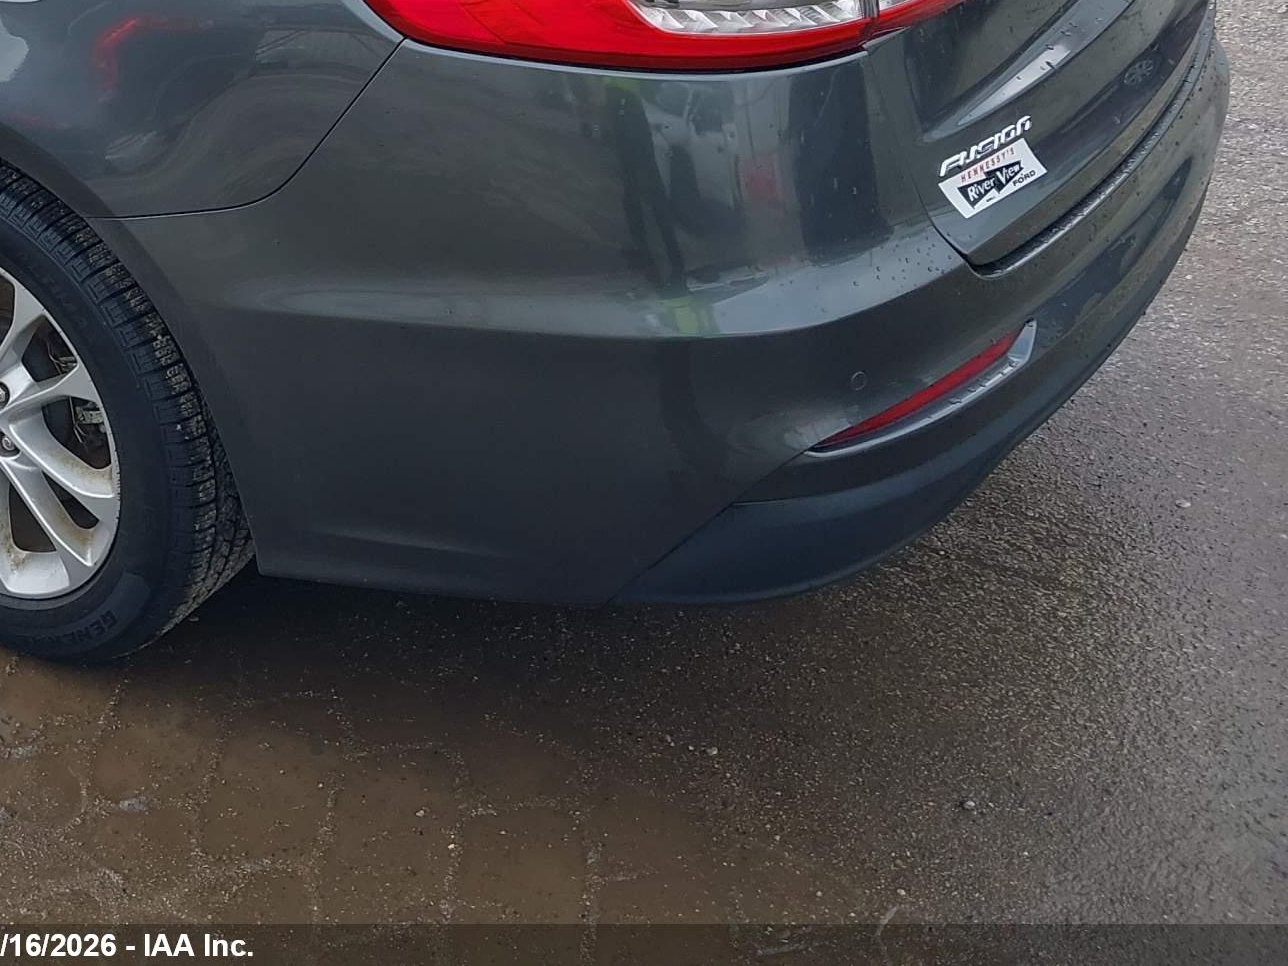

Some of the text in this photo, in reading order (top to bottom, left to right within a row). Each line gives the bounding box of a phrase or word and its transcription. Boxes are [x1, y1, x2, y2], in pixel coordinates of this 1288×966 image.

[960, 146, 1015, 183] HENNESSY'S
[967, 163, 1020, 202] River View
[1013, 169, 1036, 187] FORD
